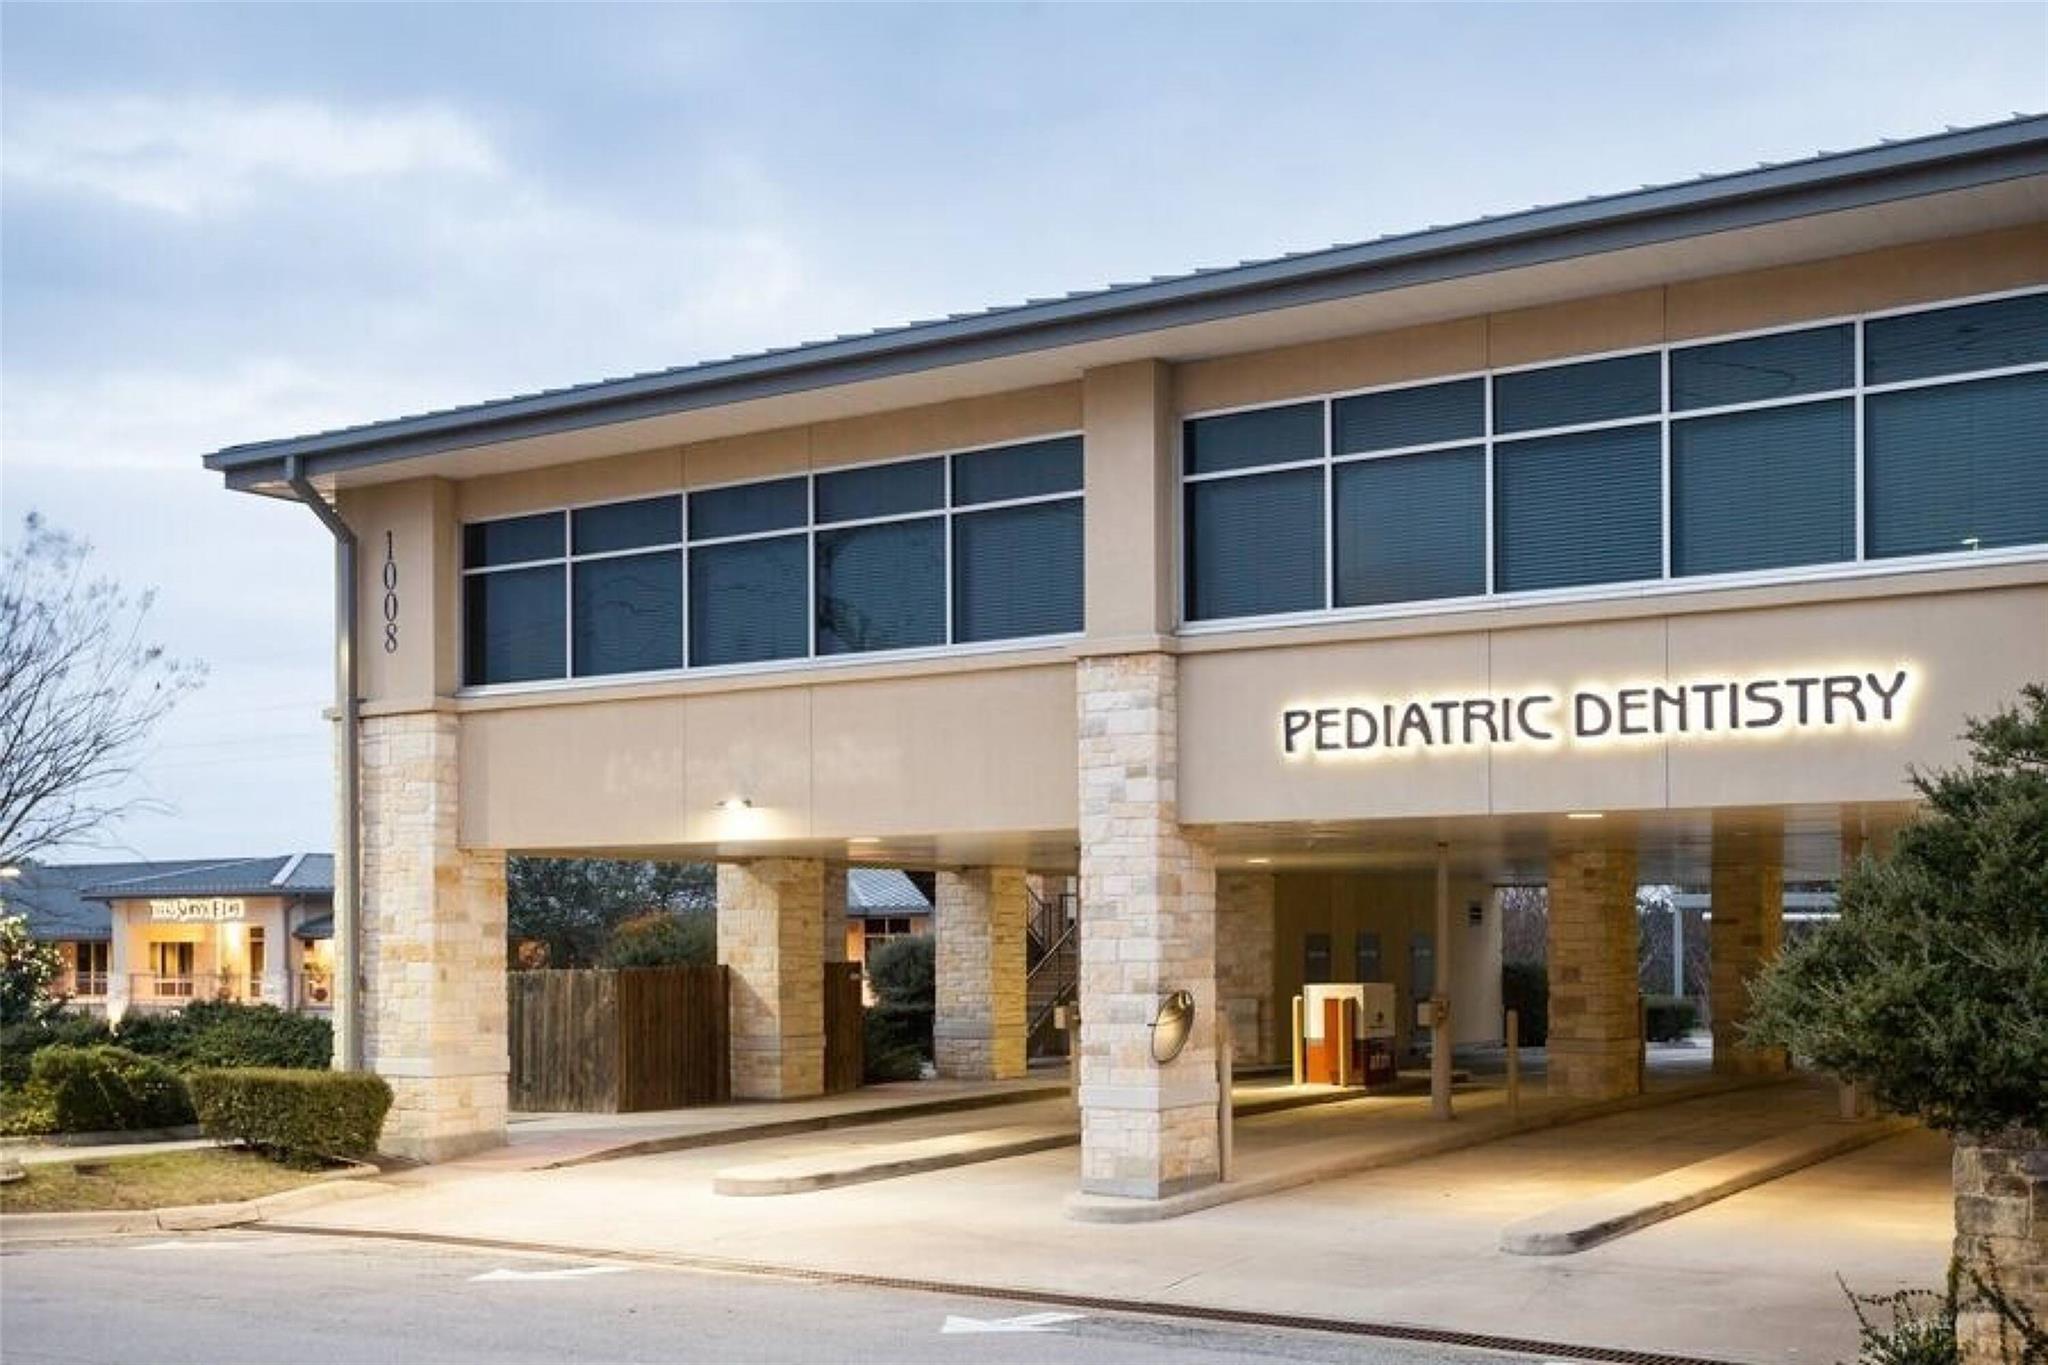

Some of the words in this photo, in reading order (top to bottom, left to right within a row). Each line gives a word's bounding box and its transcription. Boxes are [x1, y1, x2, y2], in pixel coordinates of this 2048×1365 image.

[384, 530, 398, 654] 1008
[1284, 695, 1552, 753] PEDIATRIC
[1576, 671, 1905, 736] DENTISTRY
